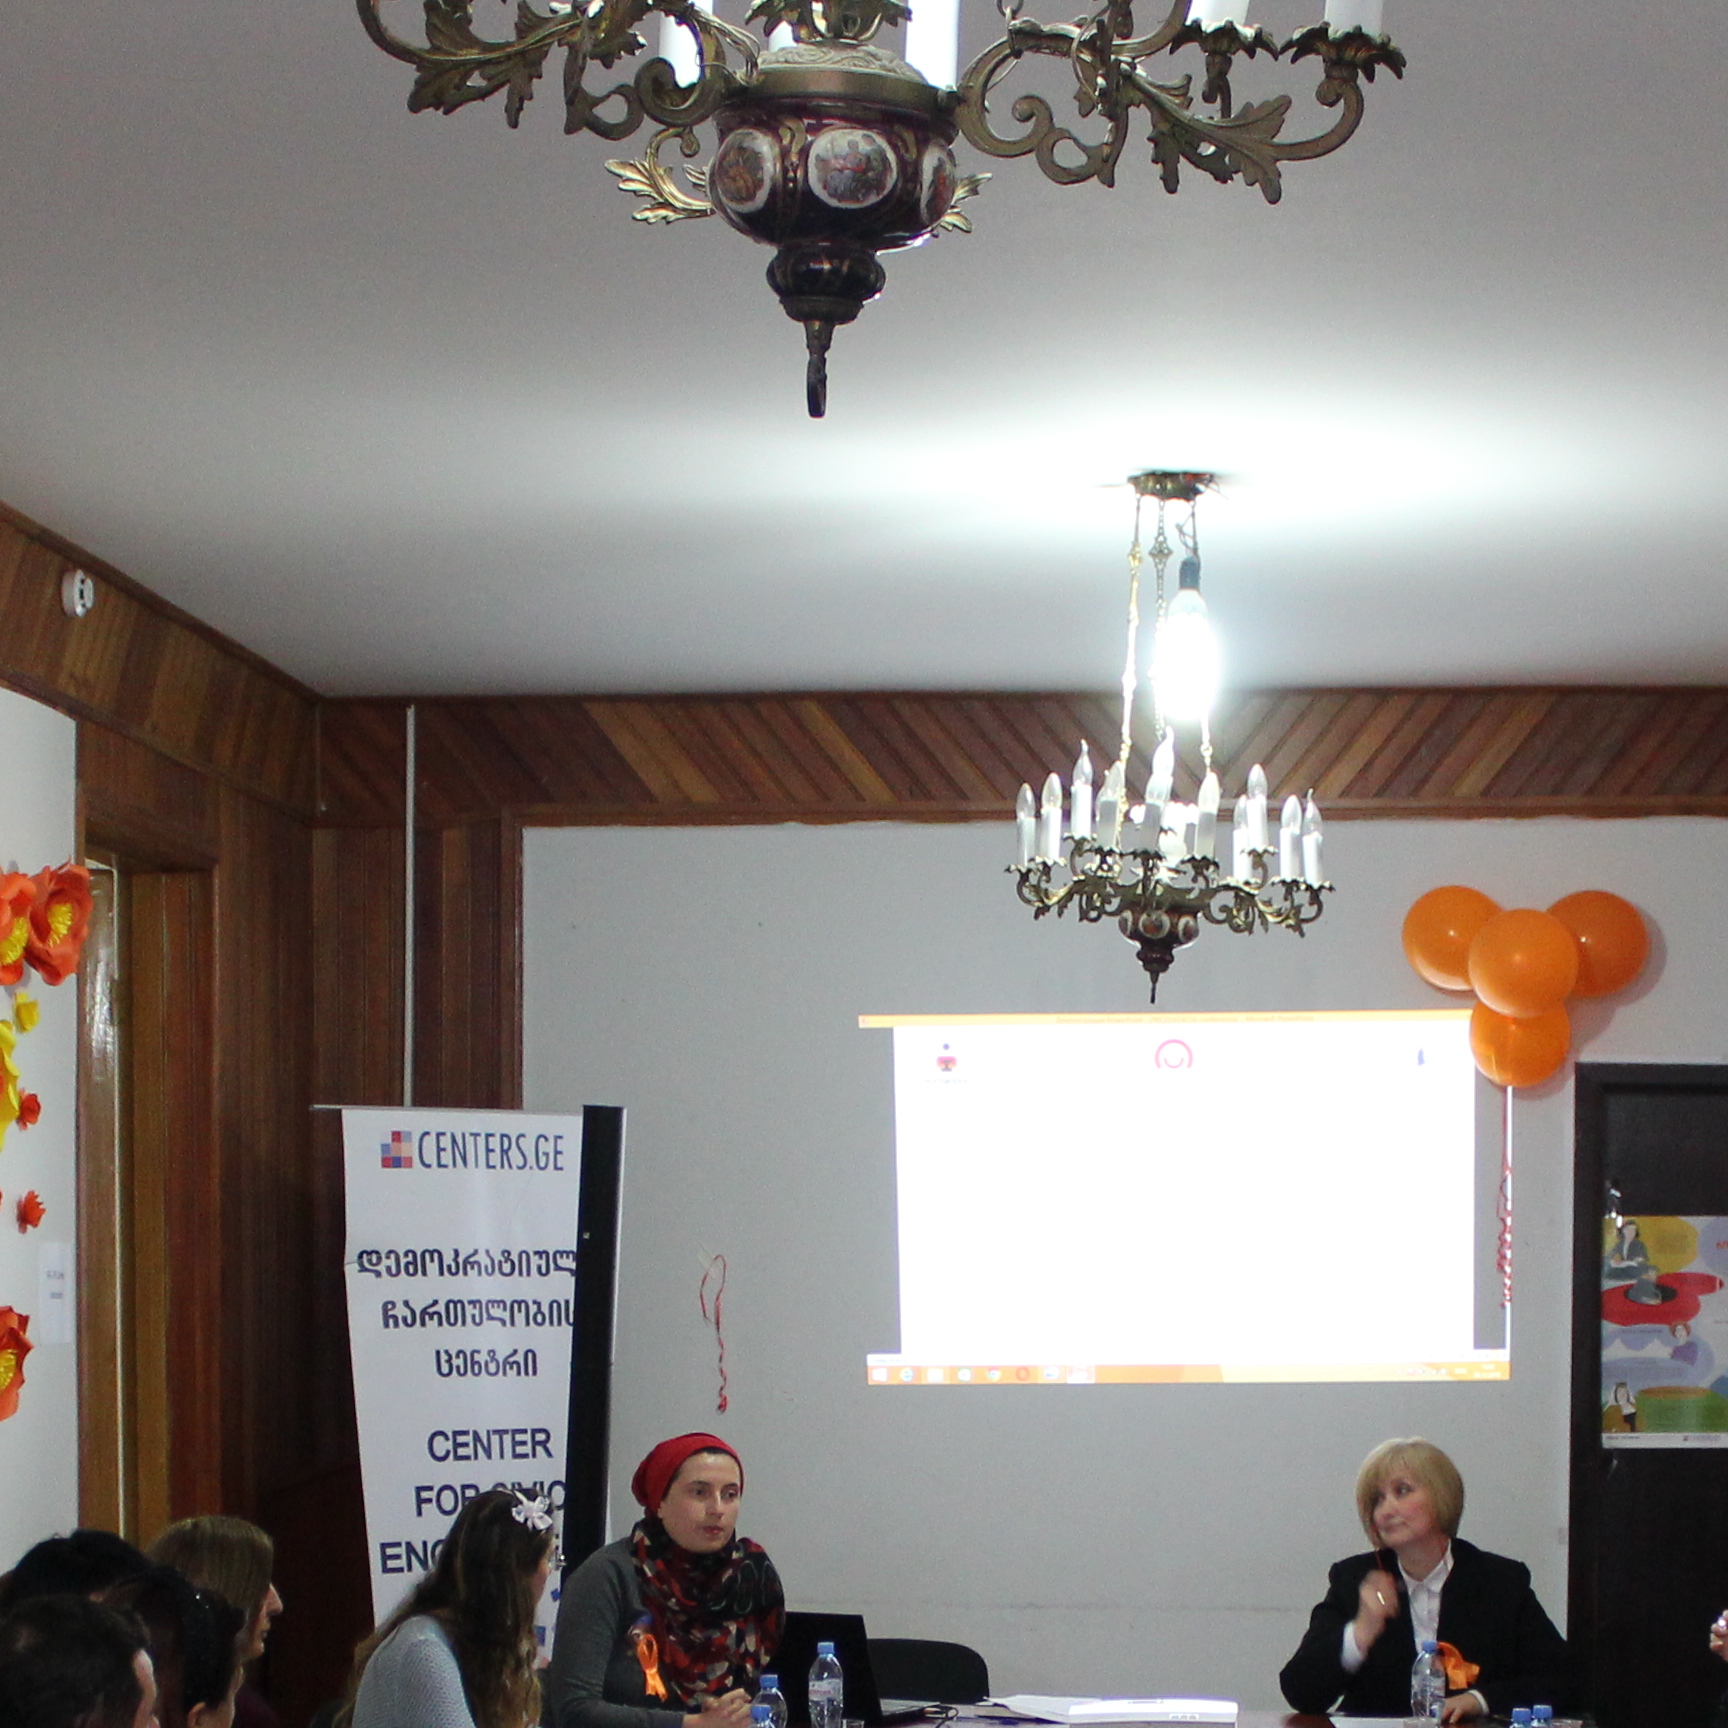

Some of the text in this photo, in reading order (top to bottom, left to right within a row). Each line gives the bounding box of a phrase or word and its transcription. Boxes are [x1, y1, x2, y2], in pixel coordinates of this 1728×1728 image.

[417, 1130, 564, 1171] CENTERS.GE
[434, 1348, 538, 1378] ცენტრი
[426, 1428, 553, 1463] CENTER
